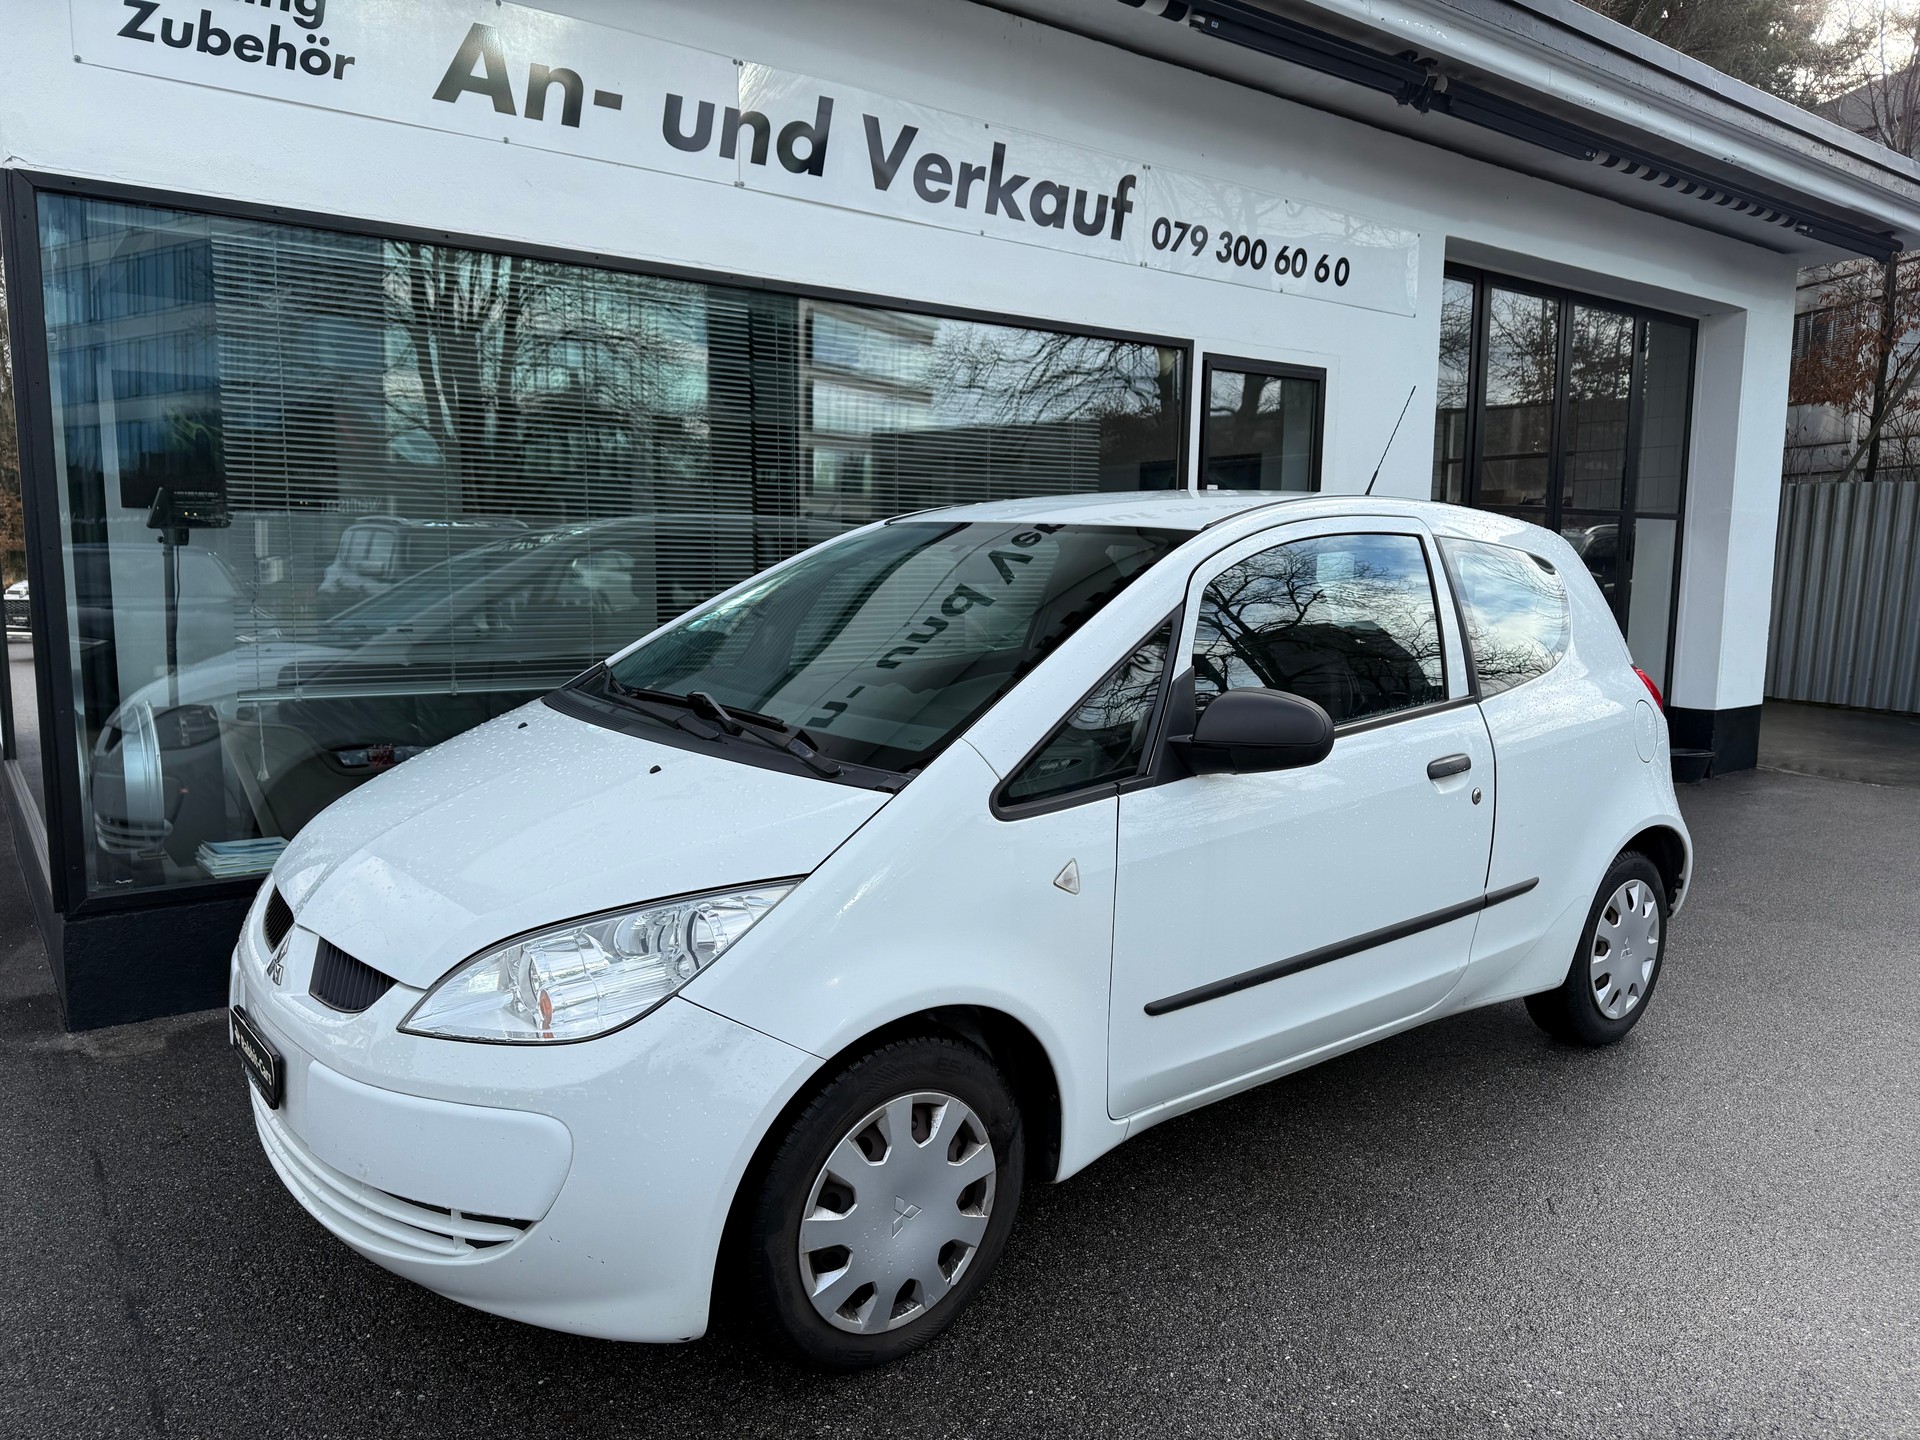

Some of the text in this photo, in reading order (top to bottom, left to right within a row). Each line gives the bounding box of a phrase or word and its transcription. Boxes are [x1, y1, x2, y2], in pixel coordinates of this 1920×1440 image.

[117, 0, 356, 81] Zubehör
[432, 22, 1137, 241] An- und Verkauf
[1151, 217, 1350, 286] 079 300 60 60
